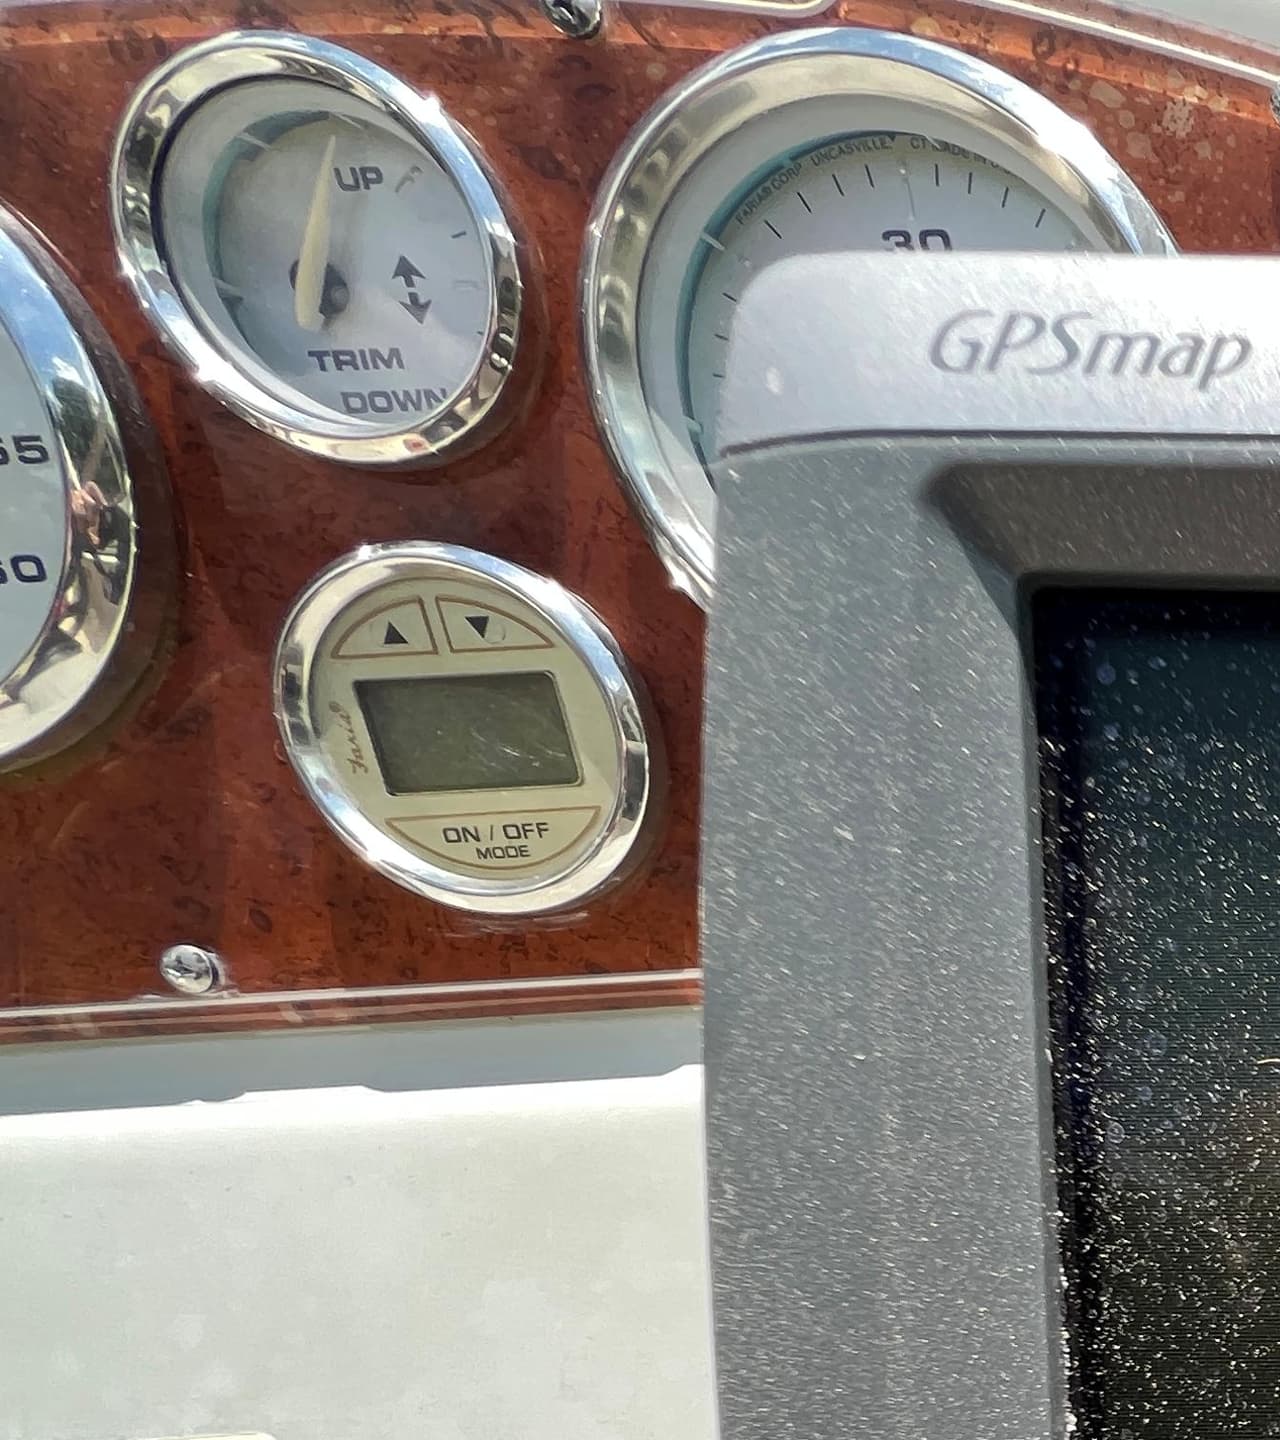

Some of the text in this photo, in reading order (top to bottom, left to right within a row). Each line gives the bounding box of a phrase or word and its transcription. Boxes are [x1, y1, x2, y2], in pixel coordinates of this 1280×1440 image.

[334, 166, 384, 192] UP
[881, 229, 952, 252] 30
[307, 347, 405, 372] TRIM
[929, 309, 1253, 392] GPSmap
[340, 388, 448, 414] DOWN
[0, 434, 50, 465] 5
[0, 554, 48, 584] 0
[443, 826, 481, 843] ON
[502, 822, 550, 840] OFF
[476, 844, 532, 860] MODE
